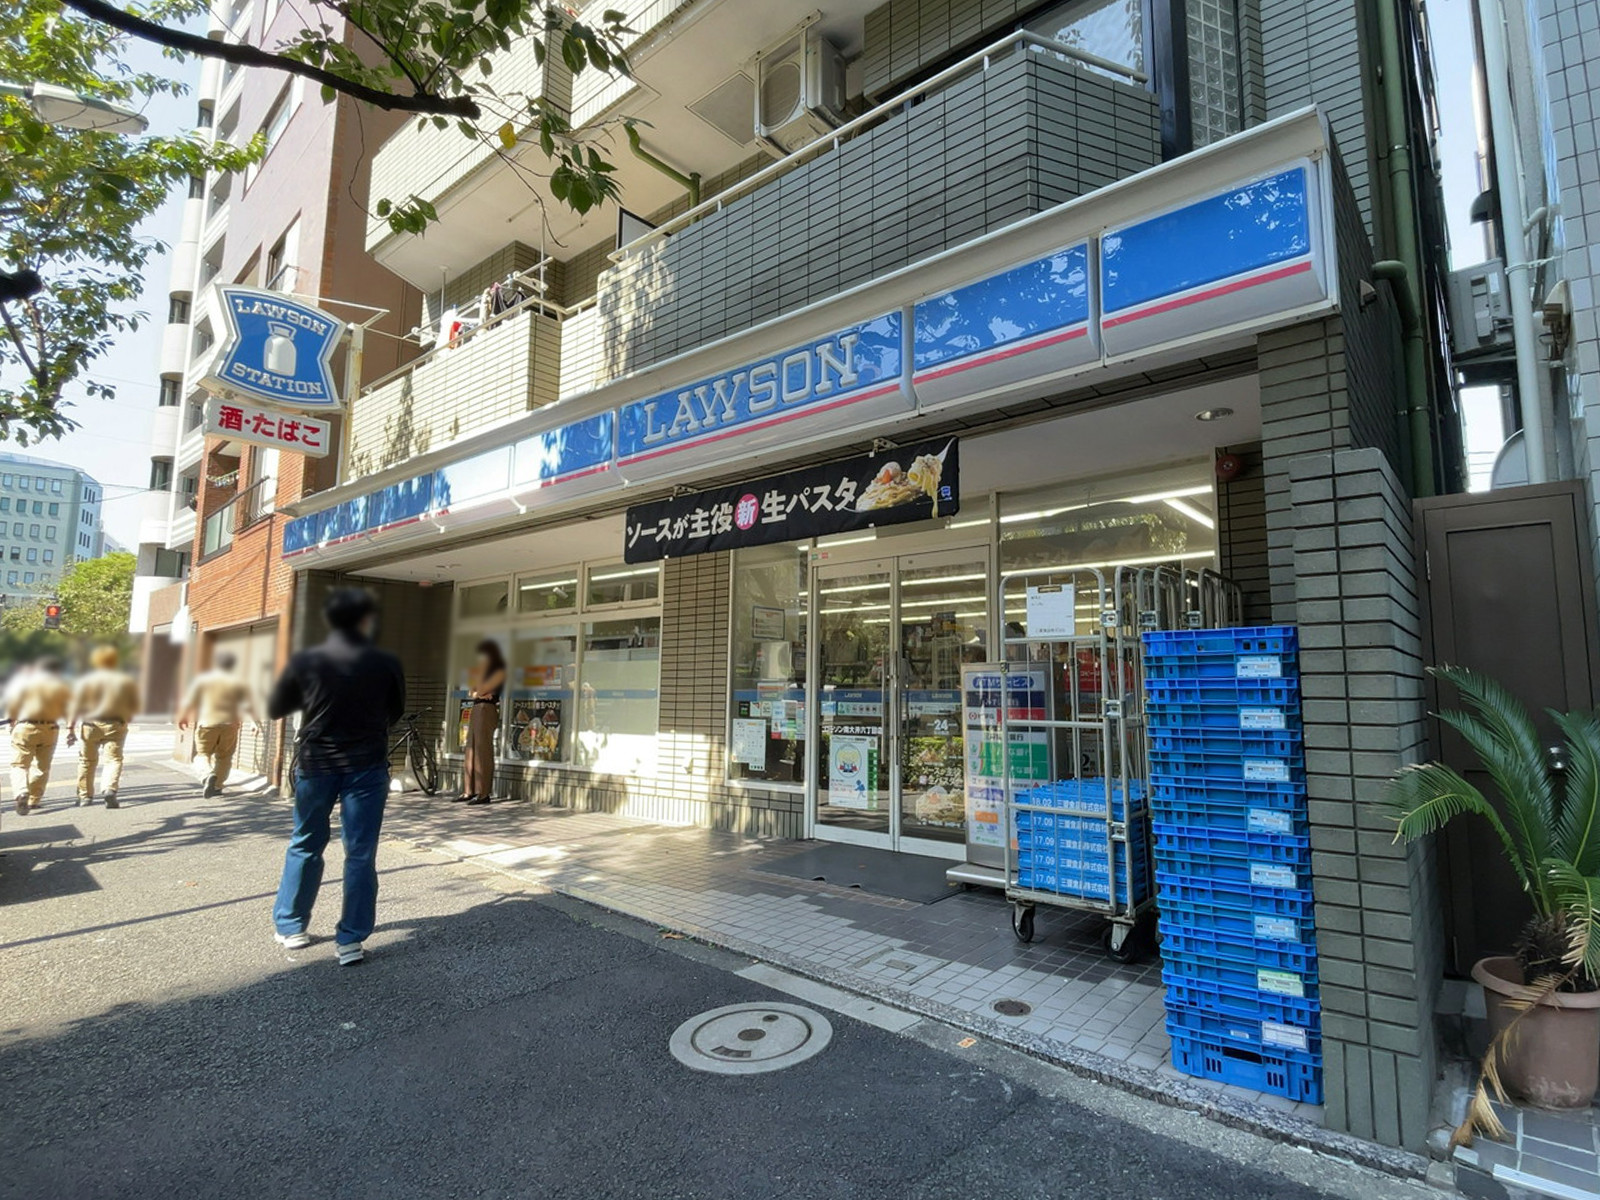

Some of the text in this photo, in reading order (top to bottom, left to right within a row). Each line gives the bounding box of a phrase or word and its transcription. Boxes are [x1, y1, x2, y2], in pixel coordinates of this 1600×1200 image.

[234, 299, 328, 337] LAWSON
[231, 361, 324, 396] STATION
[642, 332, 859, 445] LAWSON
